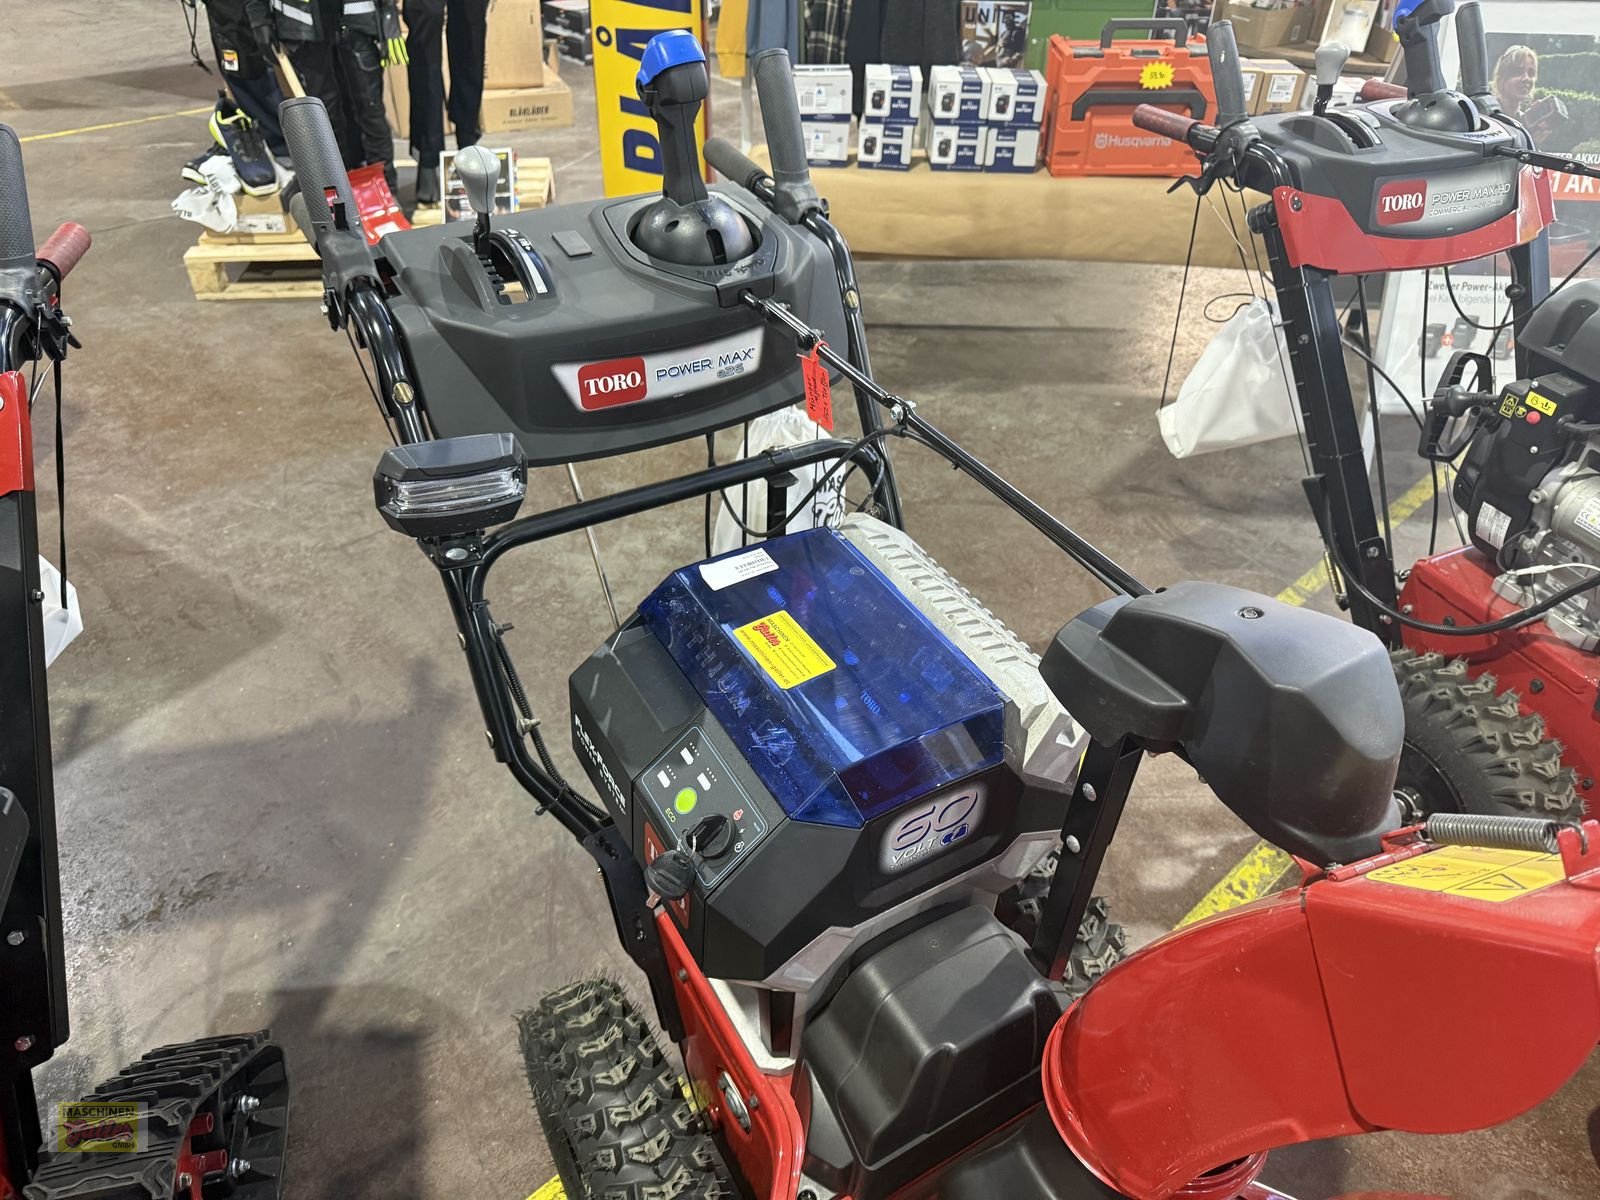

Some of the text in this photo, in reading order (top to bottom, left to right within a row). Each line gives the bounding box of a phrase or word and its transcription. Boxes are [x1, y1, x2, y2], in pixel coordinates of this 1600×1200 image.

[1108, 135, 1172, 148] Husqvarna
[1563, 174, 1600, 193] AK
[1382, 192, 1423, 213] TORO
[1431, 190, 1471, 206] POWER
[1472, 186, 1497, 201] MAX
[655, 347, 753, 382] POWER MAX
[584, 371, 642, 397] TORO
[574, 713, 626, 808] FLEX-FORCE
[664, 807, 677, 823] ECO
[890, 789, 978, 851] 60
[892, 836, 939, 864] VOLT
